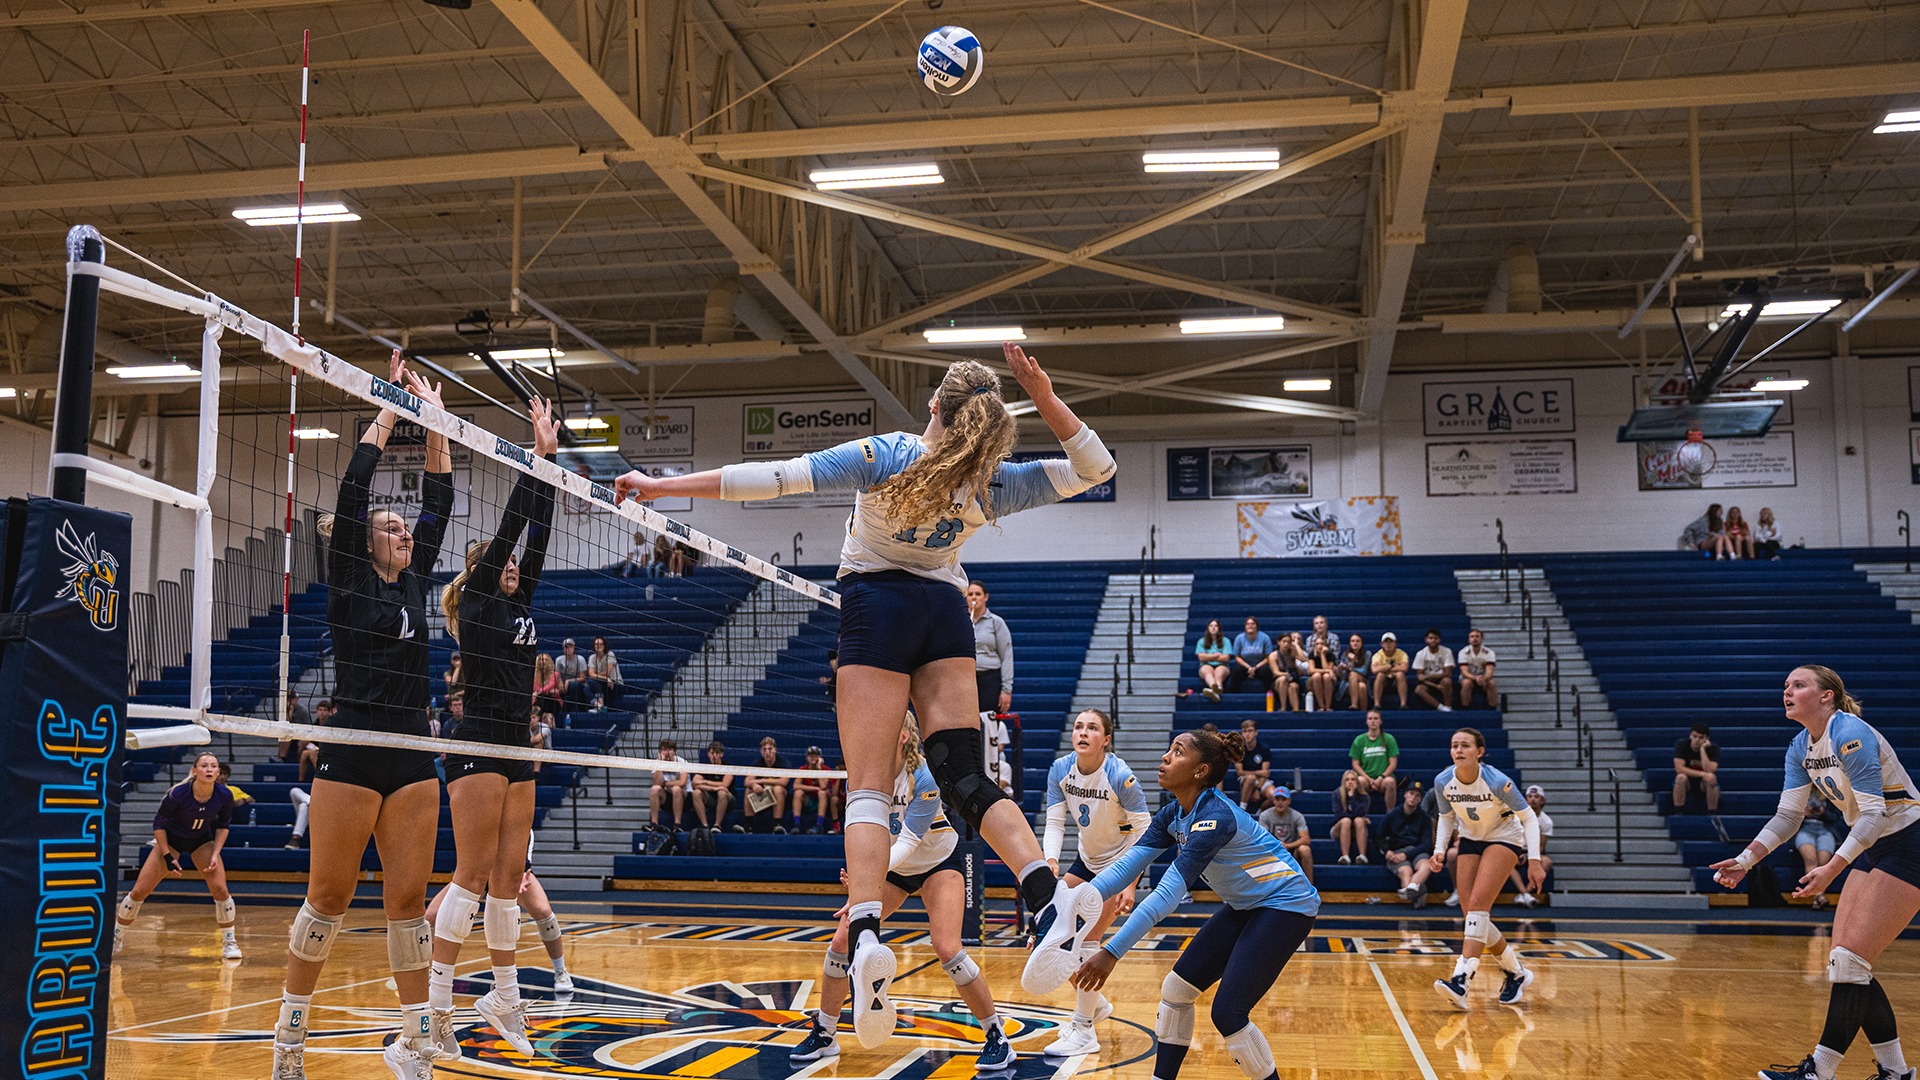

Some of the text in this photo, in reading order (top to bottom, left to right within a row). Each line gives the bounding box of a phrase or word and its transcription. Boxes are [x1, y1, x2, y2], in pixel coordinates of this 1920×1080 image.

[920, 57, 950, 82] molten
[370, 375, 423, 418] CEDARVILLE
[1436, 387, 1560, 424] GRACE
[625, 423, 689, 436] COUTYARD
[778, 408, 872, 429] GenSend
[1438, 417, 1560, 427] BAPTIST CHURCH
[495, 437, 535, 471] CEDARVILLE
[1286, 528, 1355, 551] SWARM
[1065, 783, 1109, 801] CEDARVILLE
[191, 818, 205, 830] 11
[1078, 803, 1091, 828] 3
[20, 698, 117, 1080] ARVILLE
[965, 853, 974, 909] sports imports
